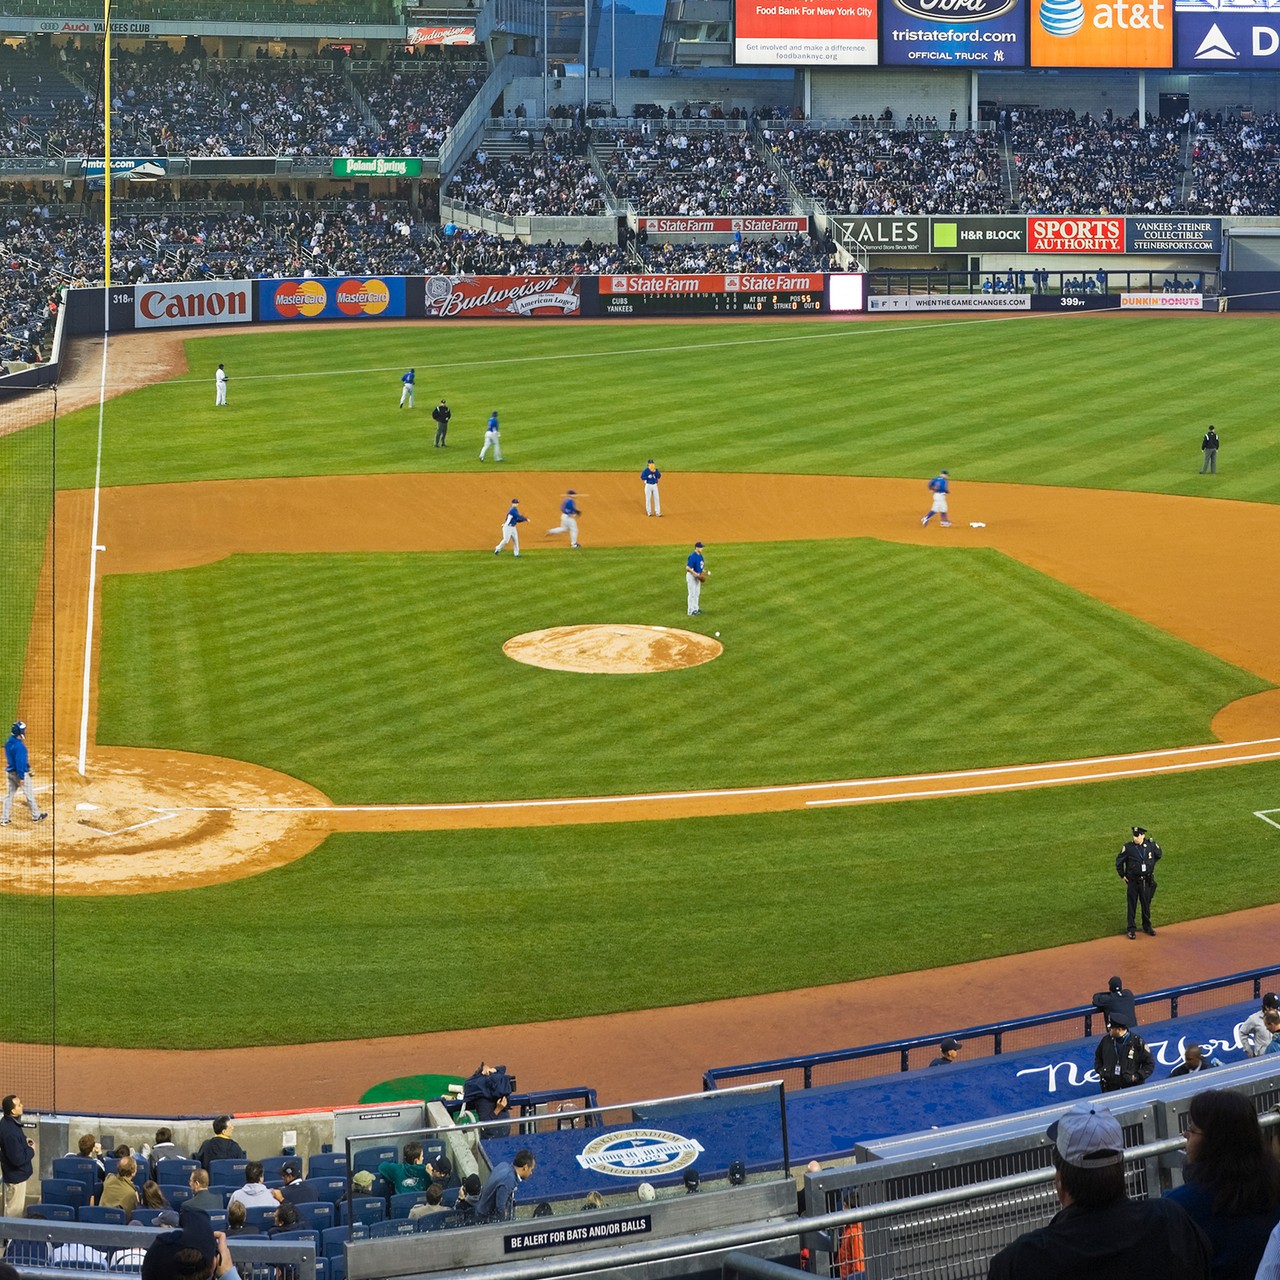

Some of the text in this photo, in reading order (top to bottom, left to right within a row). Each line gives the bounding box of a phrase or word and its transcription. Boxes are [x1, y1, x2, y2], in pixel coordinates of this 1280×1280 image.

[756, 6, 872, 17] Food Bank For New York City
[62, 23, 150, 32] Audi YAKEES CLUB
[408, 27, 466, 45] Budweiser
[892, 29, 1016, 42] tristateford.com
[908, 52, 988, 60] OFFICIAL TRUCK
[81, 160, 135, 168] Amtra.com
[346, 159, 406, 174] Poland Spring
[842, 222, 918, 241] ZALES
[961, 231, 1020, 240] H&R BLOCK
[1034, 221, 1119, 238] SPORTS
[1144, 231, 1203, 239] COLLECTIBLES
[1134, 242, 1212, 250] STEINERSPORTS.COM
[140, 289, 246, 319] Canon
[275, 292, 325, 306] MasterCard
[337, 291, 387, 305] MasterCard
[432, 278, 558, 317] Budweiser
[520, 297, 575, 310] American Lager
[1122, 297, 1199, 306] DUNKIN' DONUTS
[1017, 1062, 1102, 1092] Ne
[625, 1131, 680, 1142] STADIUM
[511, 1219, 646, 1248] BE ALERT FOR BATS AND/OR BALLS
